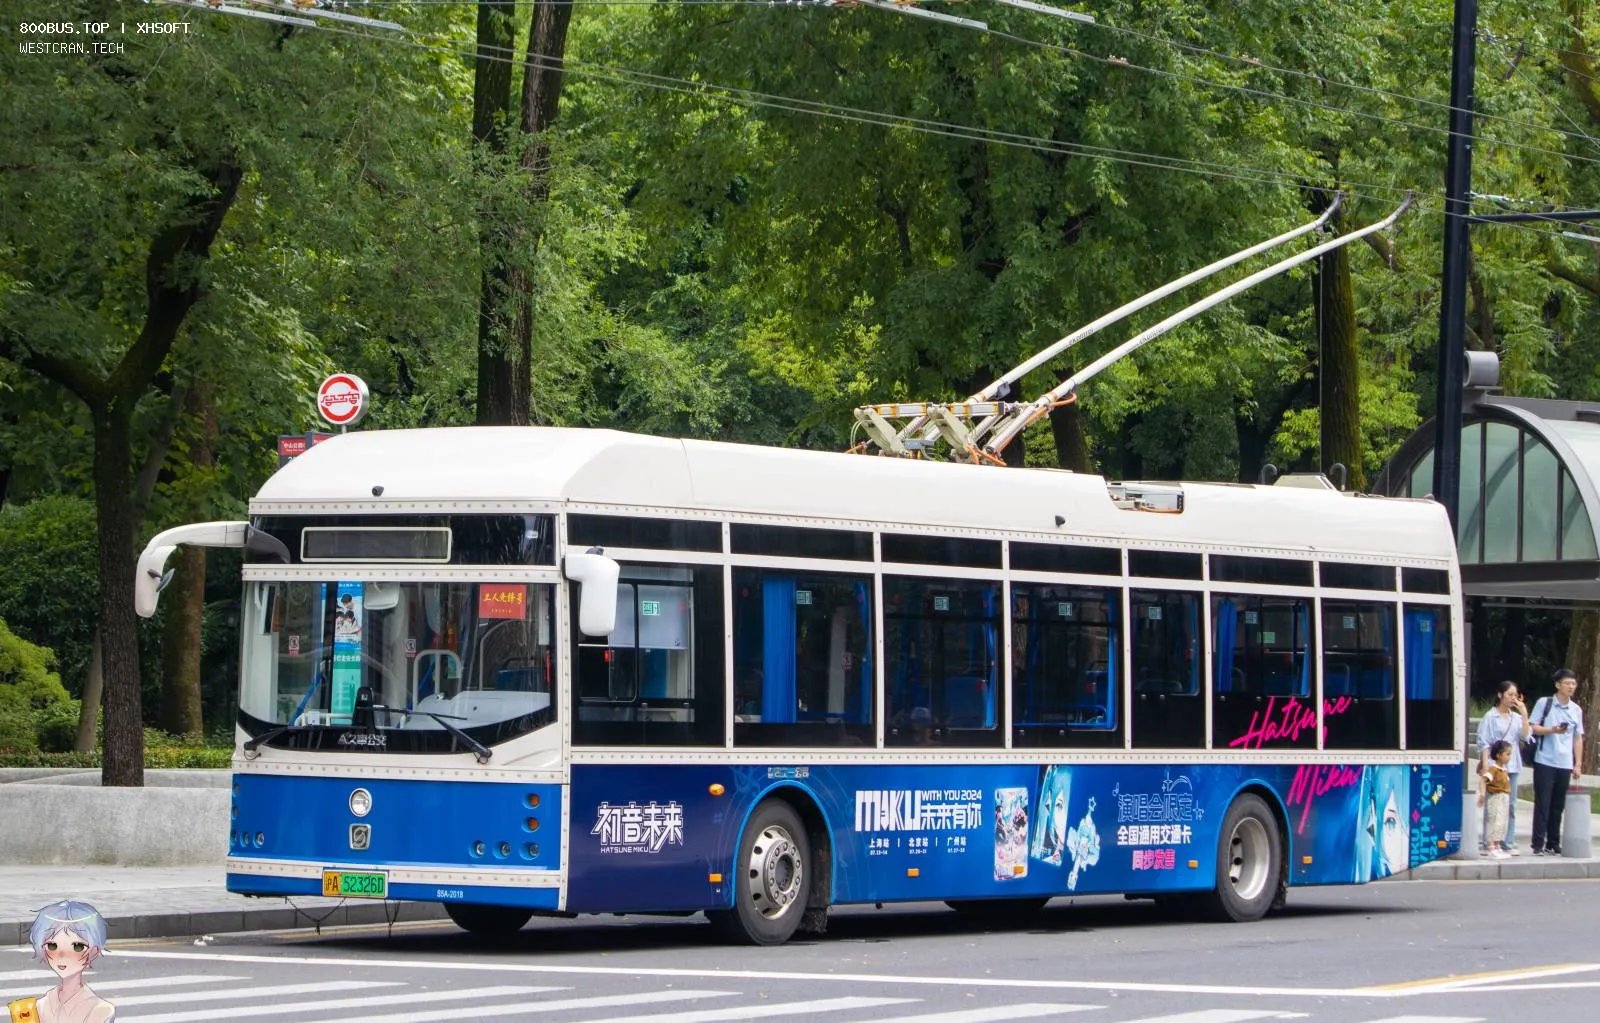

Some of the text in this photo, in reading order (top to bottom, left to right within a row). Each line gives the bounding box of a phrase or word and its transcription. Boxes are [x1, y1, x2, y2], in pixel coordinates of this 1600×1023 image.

[921, 789, 983, 801] WITH YOU 2024
[920, 802, 982, 830] 未来有你
[1117, 792, 1193, 823] 演唱会限定
[592, 801, 683, 852] 初音未来
[1117, 824, 1193, 846] 全国通用交通卡
[869, 837, 890, 848] 上海站
[908, 837, 929, 847] 北京站
[946, 836, 967, 847] 广州站
[1132, 849, 1176, 871] 同步发售
[343, 875, 385, 894] 52326D
